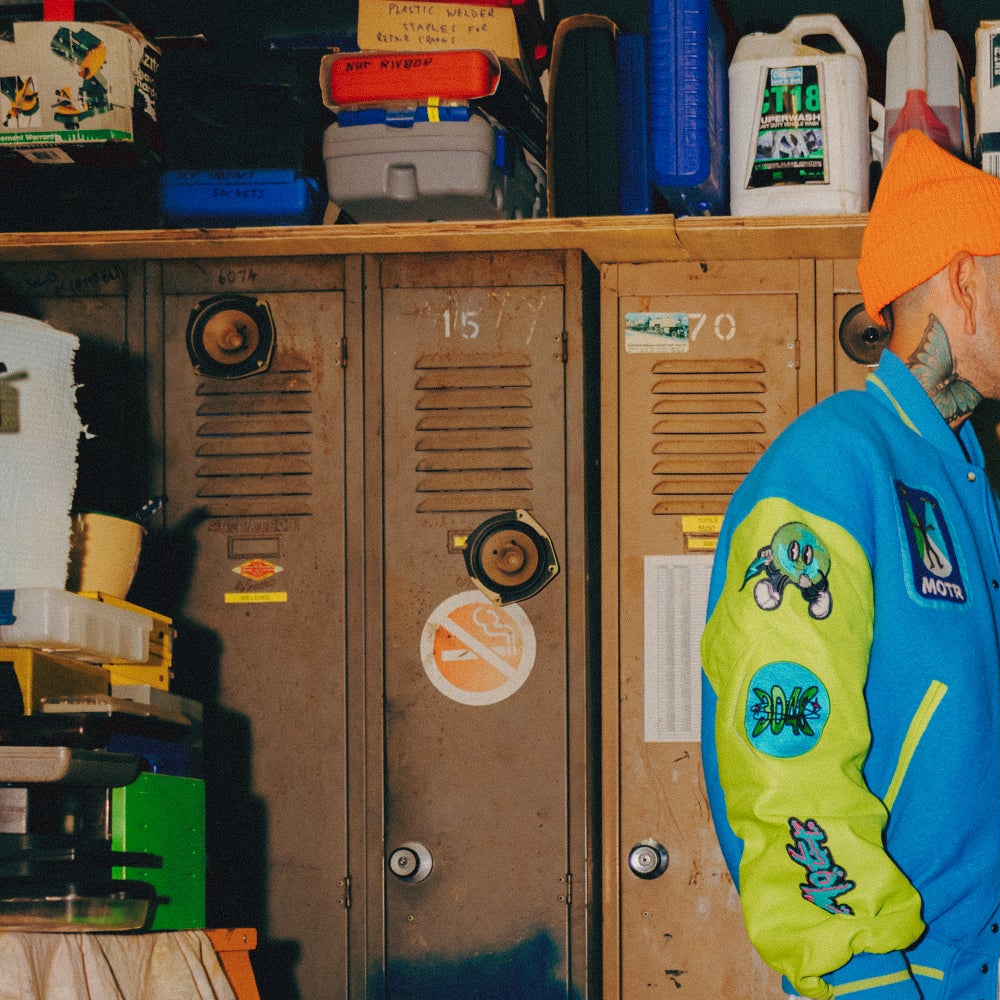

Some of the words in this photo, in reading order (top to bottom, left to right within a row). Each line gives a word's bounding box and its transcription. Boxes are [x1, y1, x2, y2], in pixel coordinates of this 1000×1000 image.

[388, 4, 434, 15] PLASTIC
[447, 8, 496, 18] WELDER
[402, 23, 456, 33] STAPLES
[468, 24, 488, 33] FOR
[345, 60, 372, 72] NUT
[761, 84, 821, 114] CT18
[761, 113, 821, 123] UPERWASH
[443, 309, 480, 340] 15
[688, 312, 737, 342] 70
[921, 576, 965, 601] MOTR
